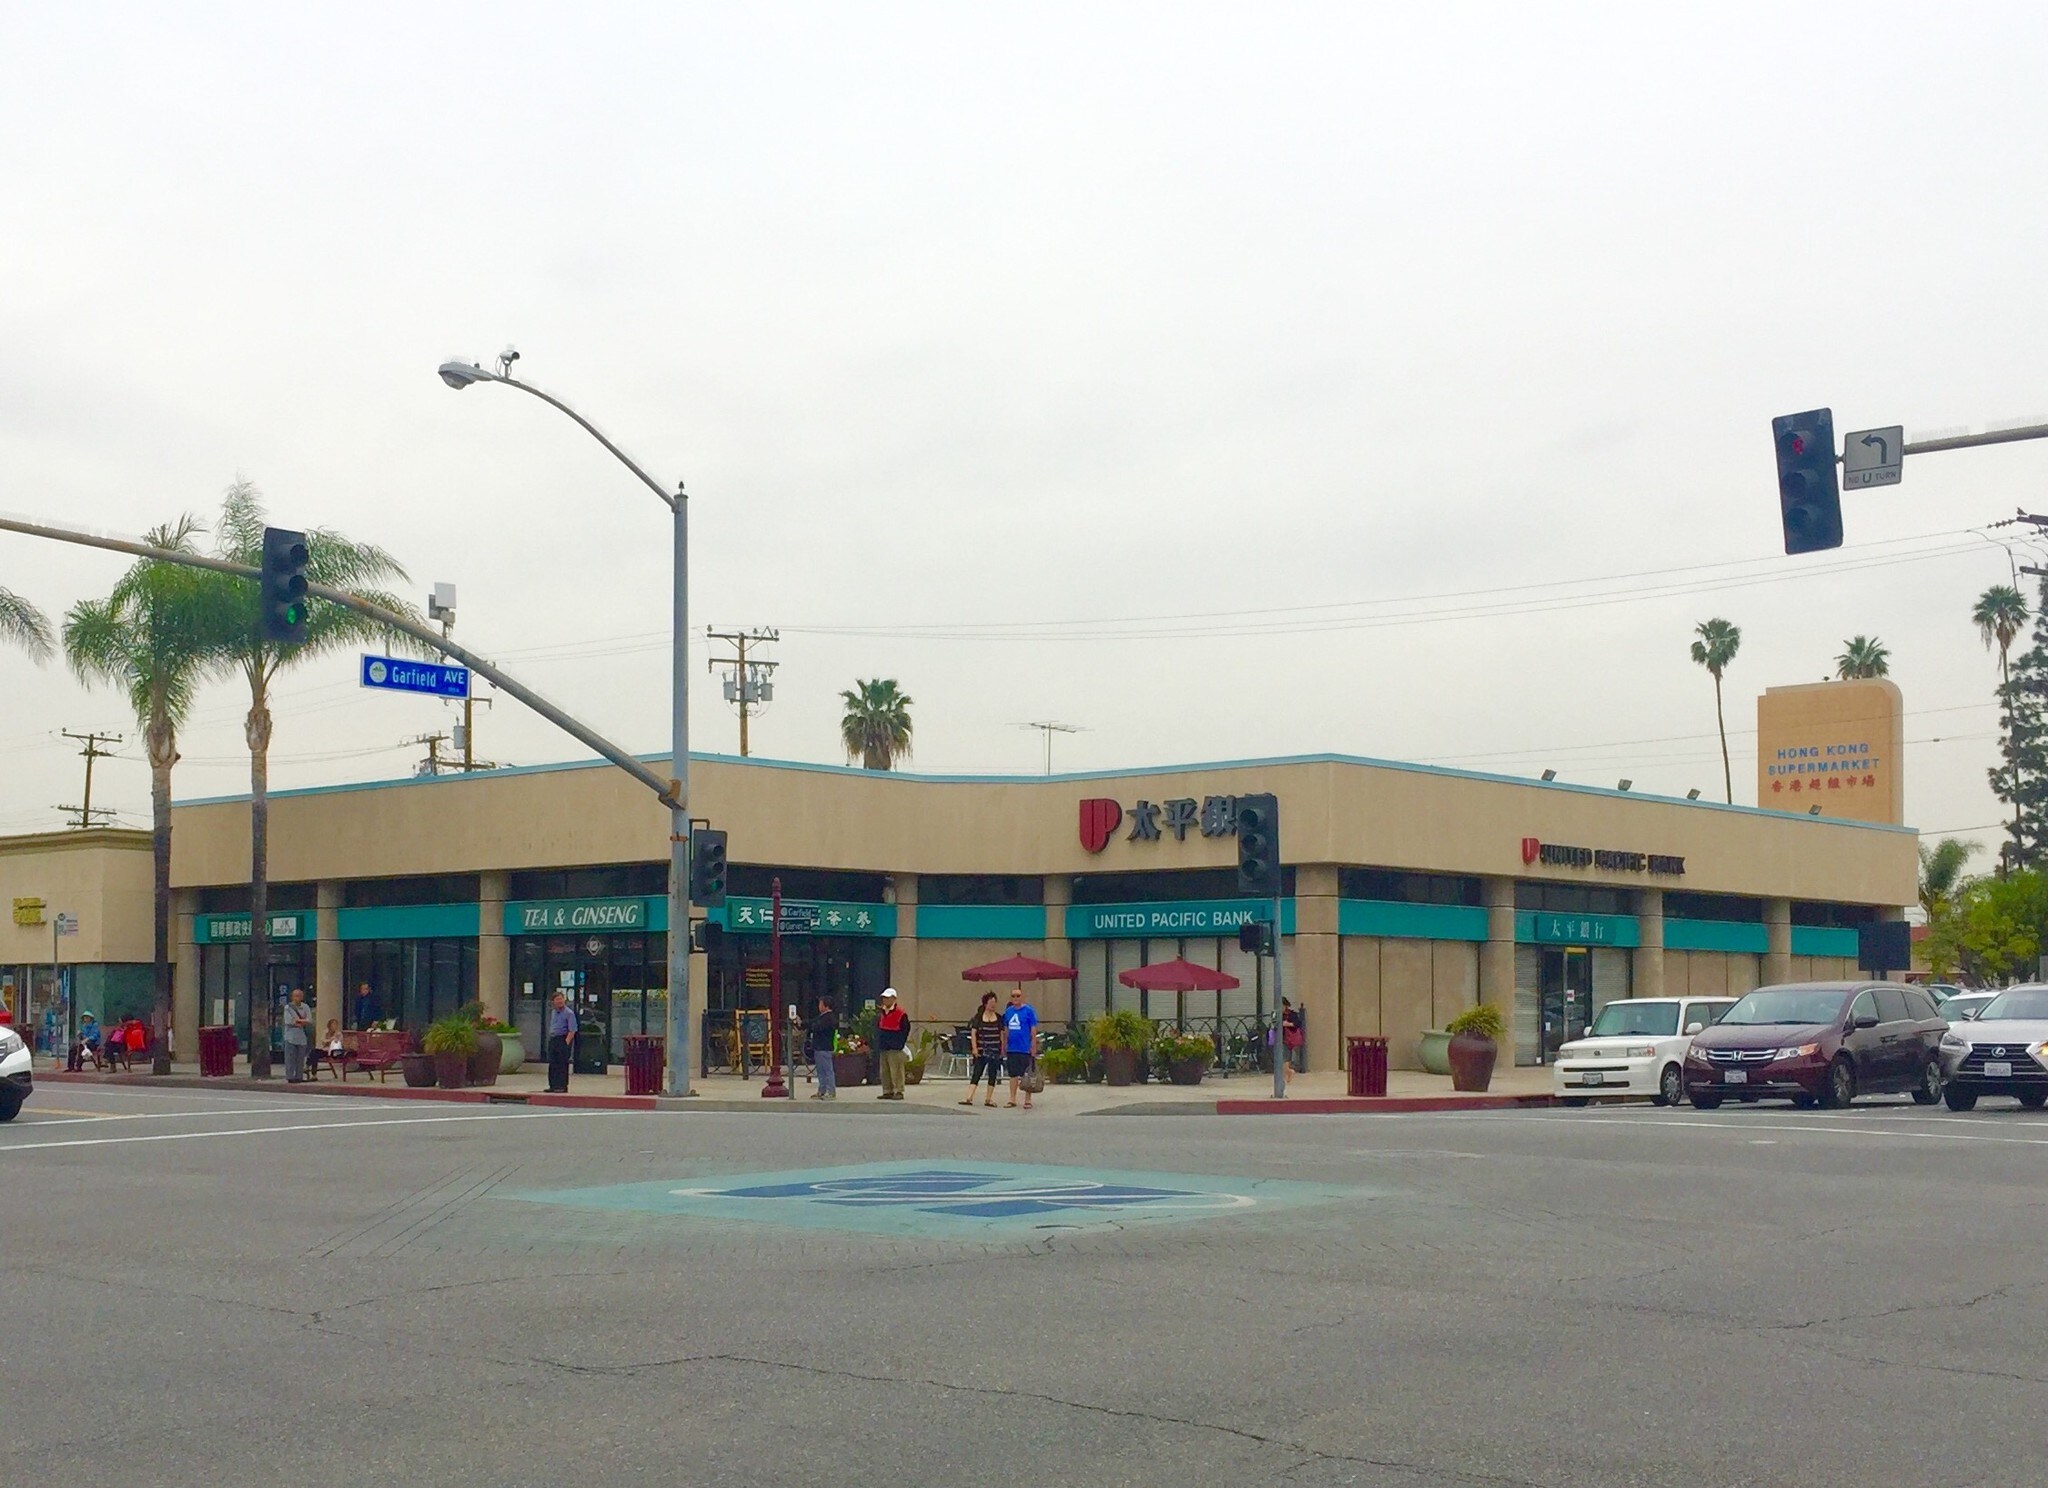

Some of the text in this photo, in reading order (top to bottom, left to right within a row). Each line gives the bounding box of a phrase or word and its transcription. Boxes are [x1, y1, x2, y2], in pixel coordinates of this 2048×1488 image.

[1862, 472, 1872, 484] U
[1875, 471, 1896, 481] TURN
[392, 666, 465, 688] Garfield AVE
[1777, 743, 1869, 759] HONG KONG
[1768, 758, 1880, 776] SUPERMARKET
[1126, 795, 1238, 842] 太平銀
[1540, 844, 1686, 875] UNITED PACIFIC BANK
[524, 904, 639, 927] TEA & GINSENG
[1094, 910, 1254, 929] UNITED PACIFIC BANK
[1550, 919, 1604, 939] 太平銀行
